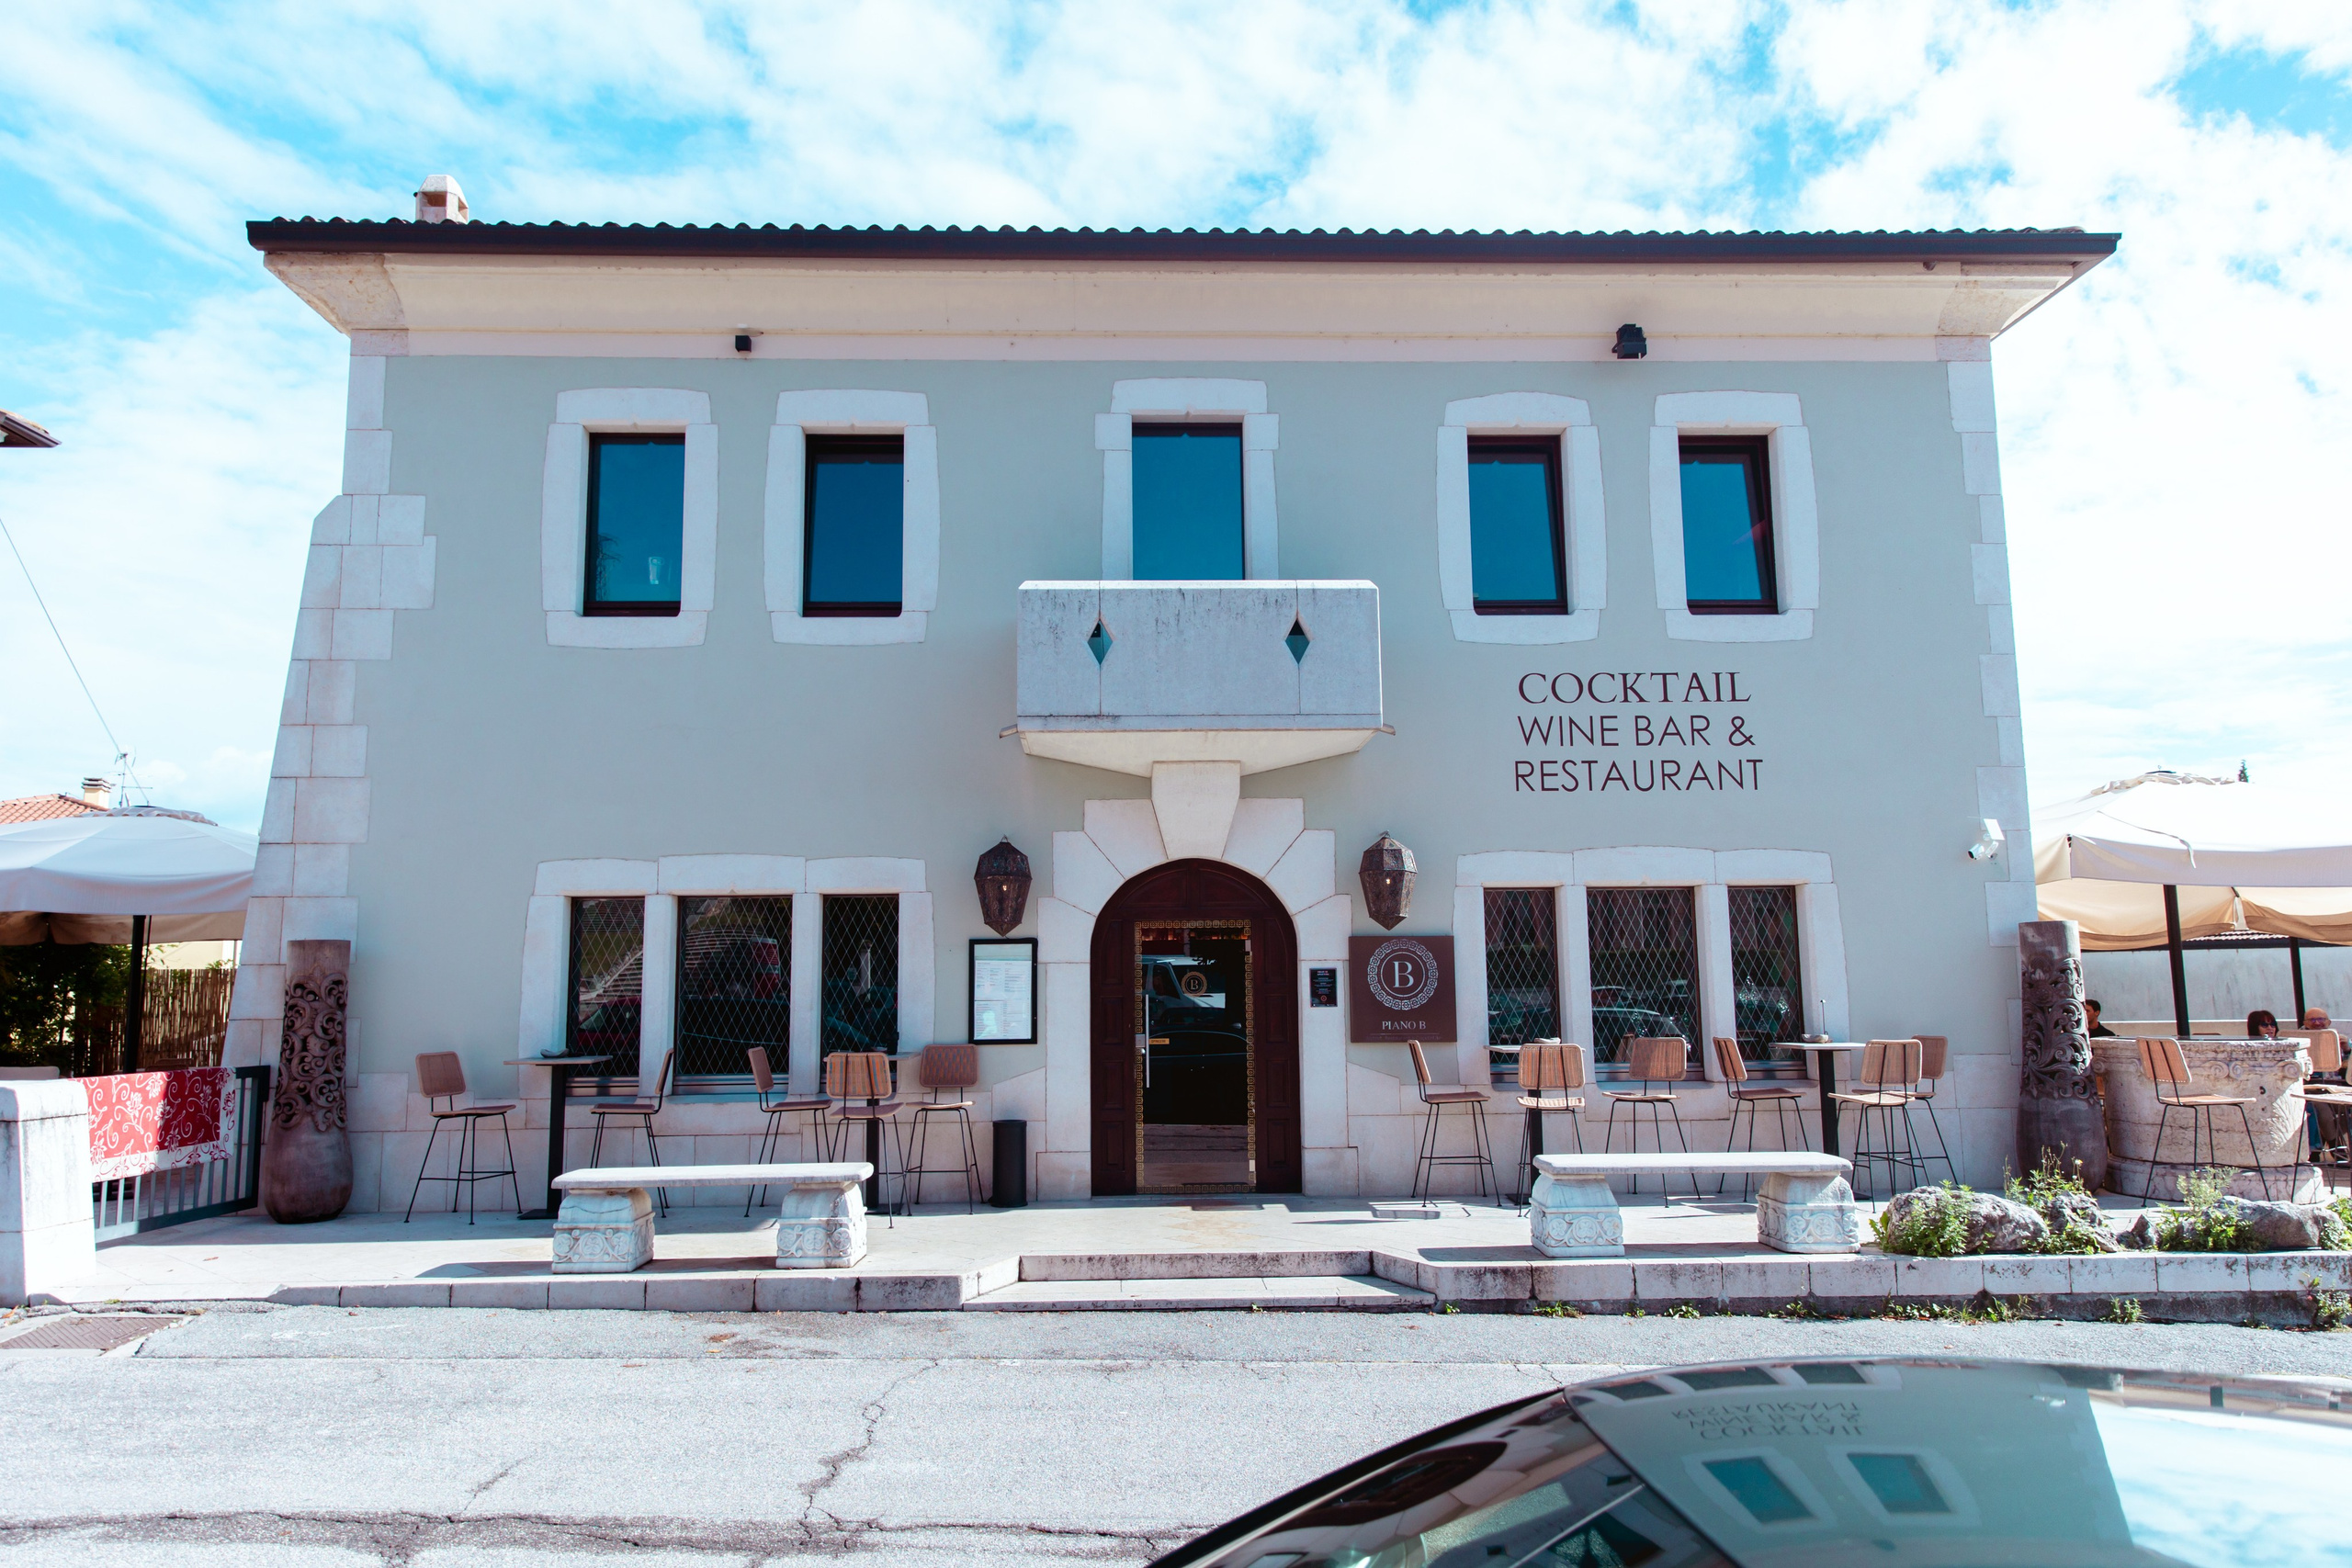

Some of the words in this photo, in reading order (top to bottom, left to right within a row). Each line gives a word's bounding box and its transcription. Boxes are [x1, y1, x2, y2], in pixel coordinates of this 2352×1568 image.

[1518, 671, 1752, 704] COCKTAIL
[1517, 716, 1619, 746] WINE
[1634, 715, 1711, 746] BAR
[1728, 716, 1756, 746] &
[1515, 759, 1763, 792] RESTAURANT
[1393, 961, 1414, 988] B
[1382, 1021, 1416, 1030] PIANO
[1419, 1021, 1426, 1030] B
